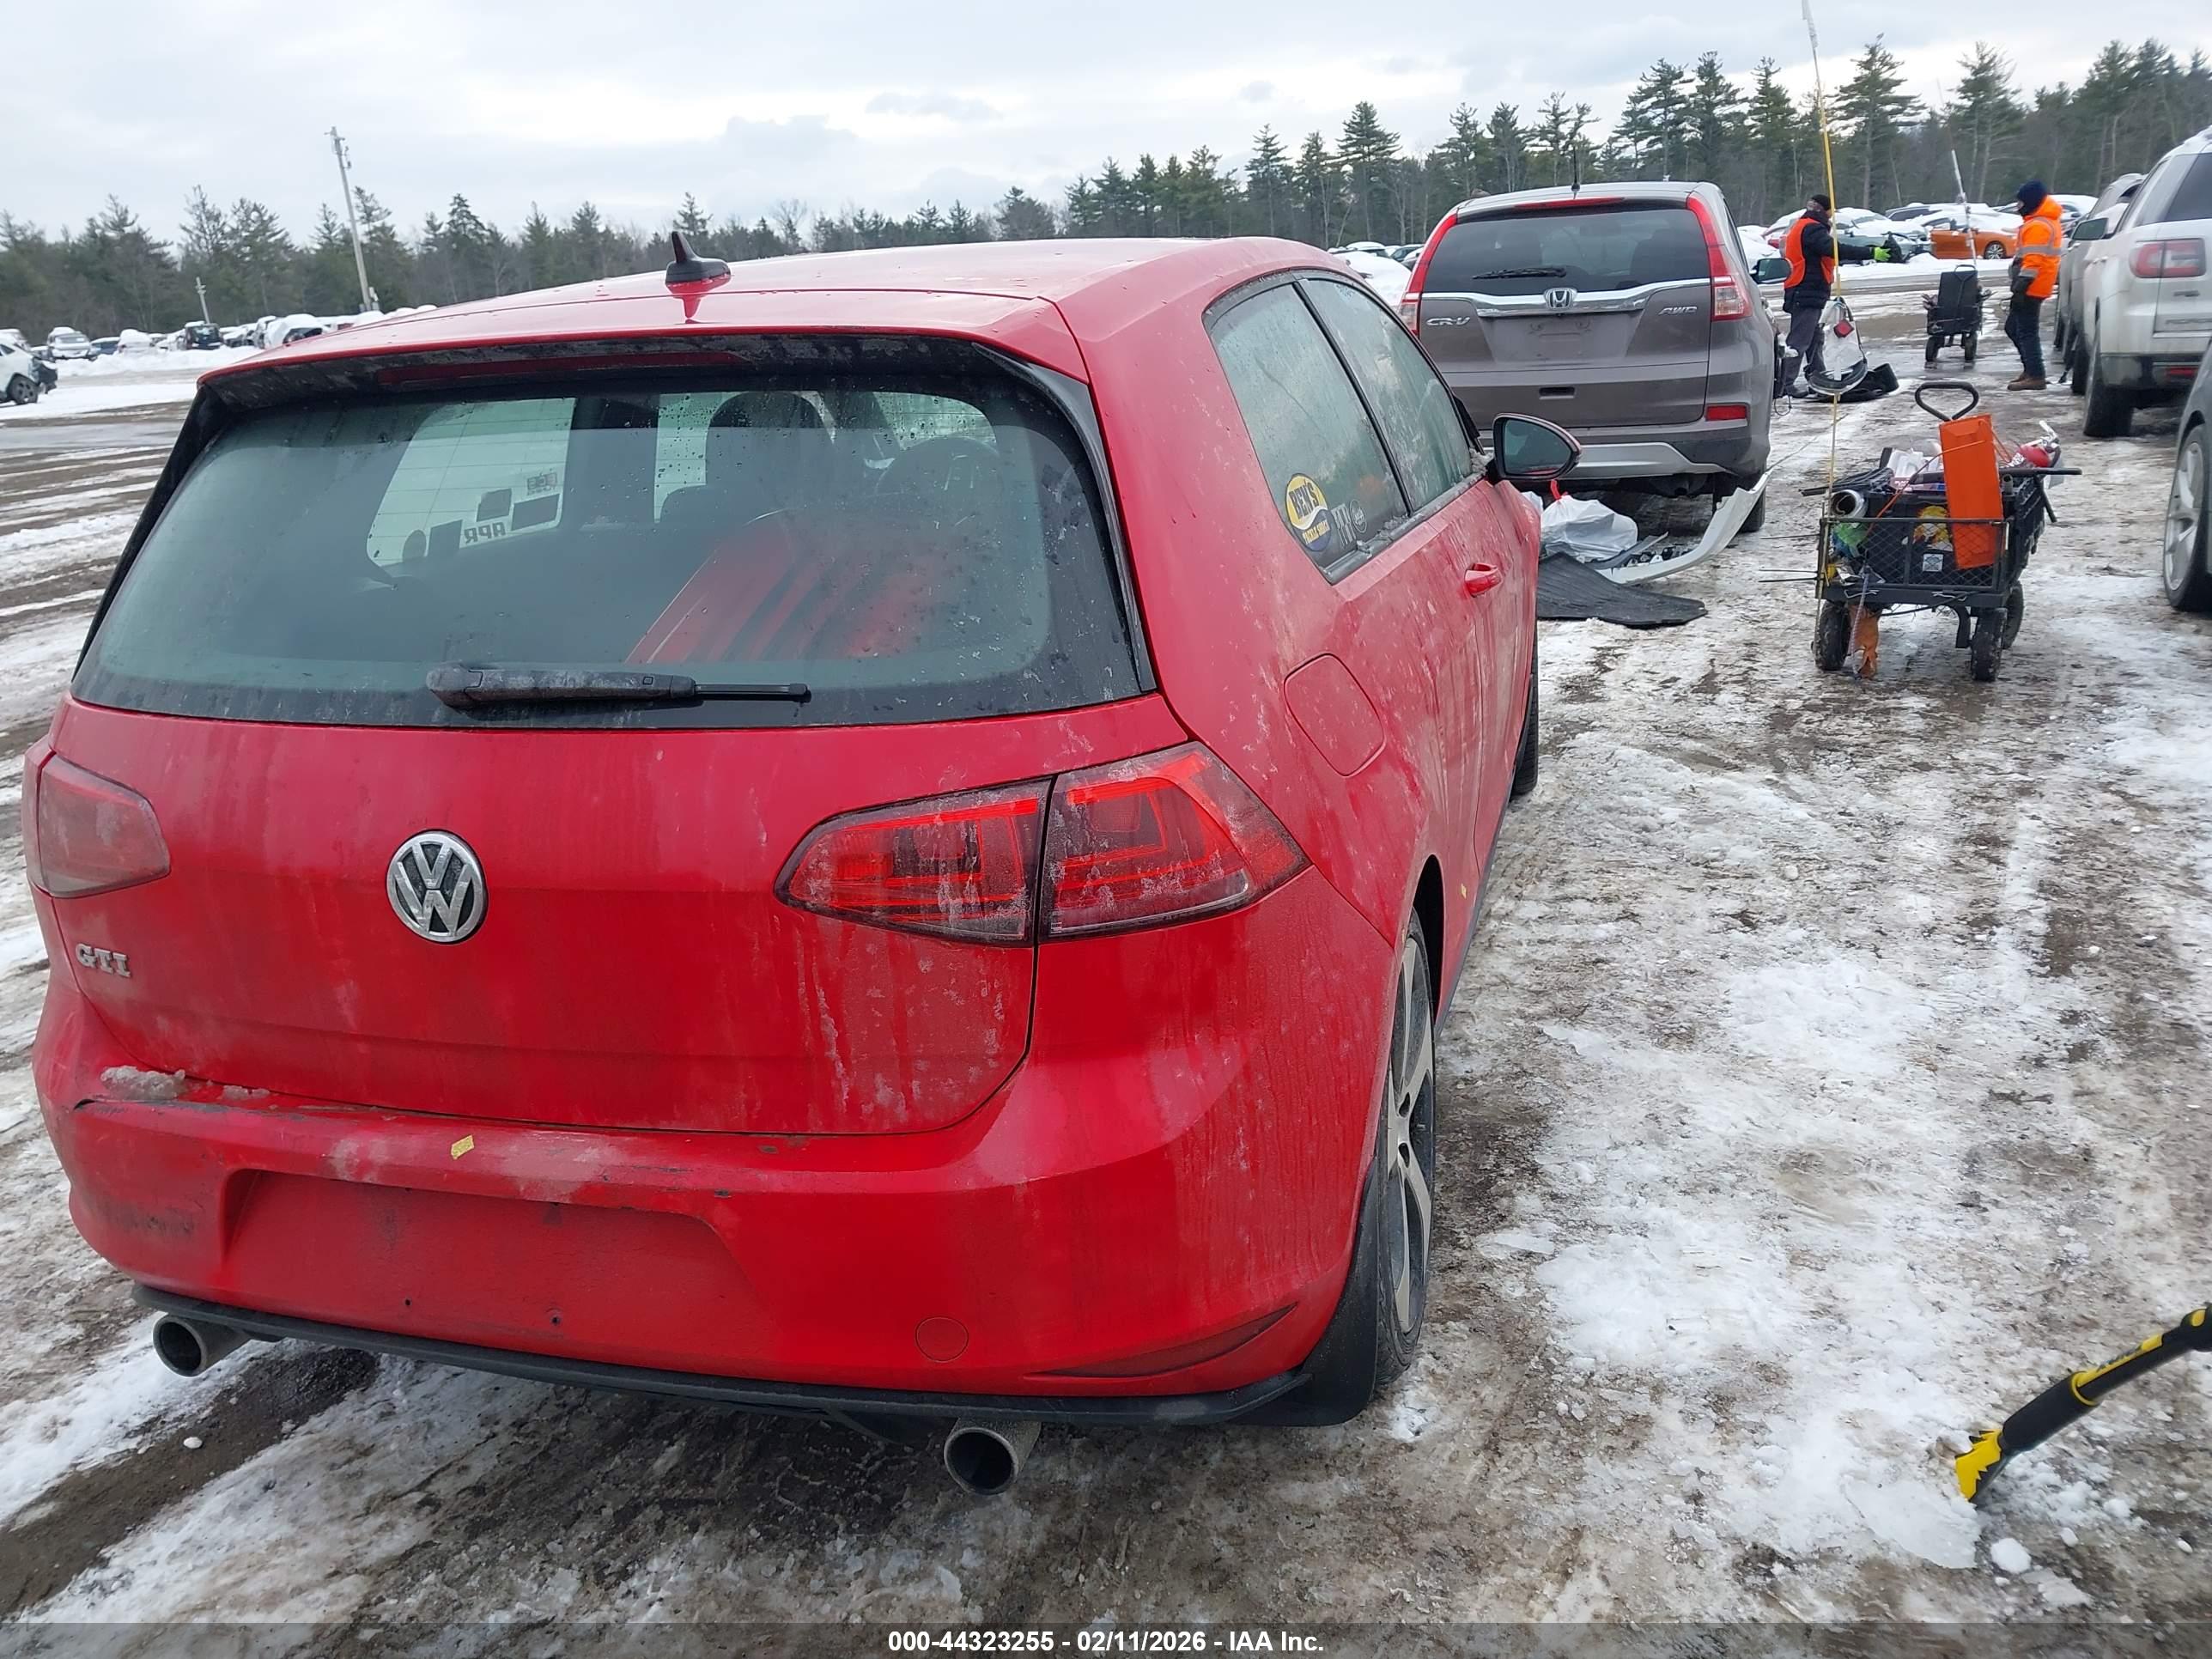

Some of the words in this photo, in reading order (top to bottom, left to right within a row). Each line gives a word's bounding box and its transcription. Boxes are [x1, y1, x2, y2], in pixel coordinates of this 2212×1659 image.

[1426, 317, 1470, 326] CR-V
[1658, 306, 1698, 315] AWD
[1288, 478, 1320, 520] BEN'S
[75, 943, 131, 978] GTI
